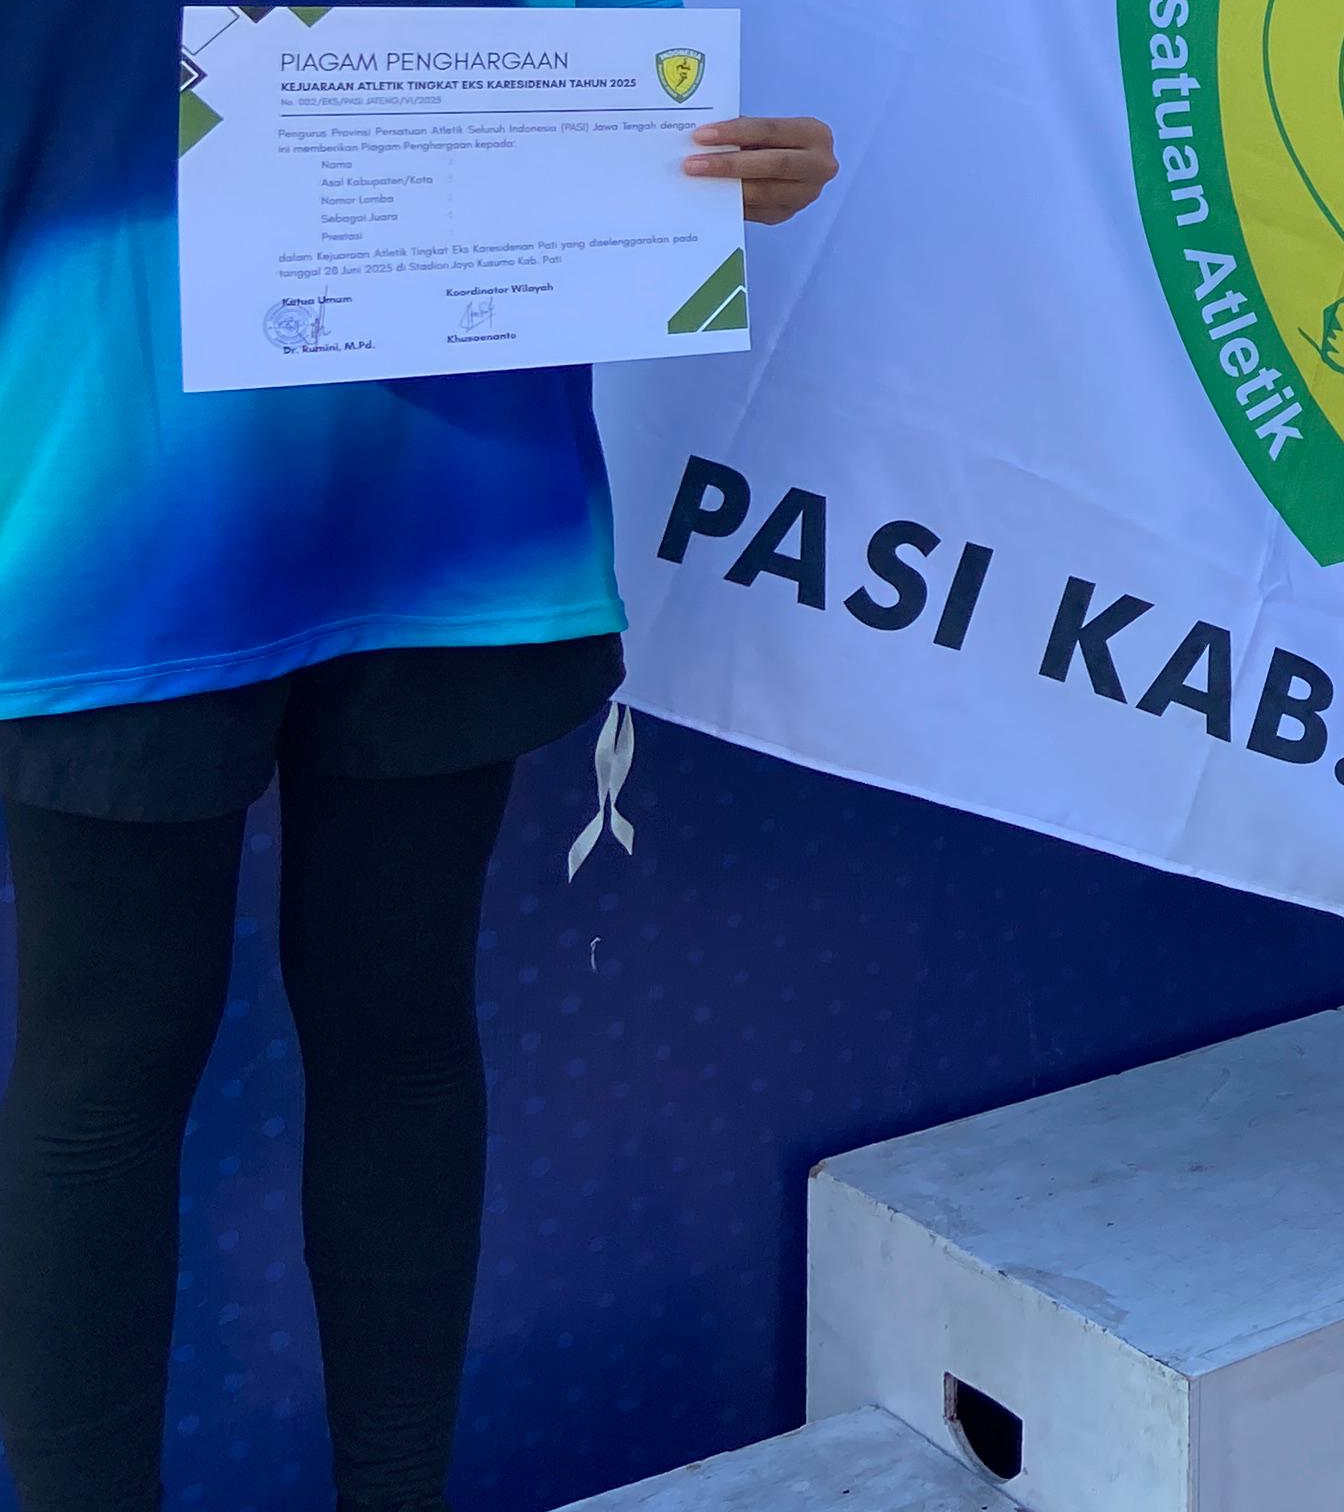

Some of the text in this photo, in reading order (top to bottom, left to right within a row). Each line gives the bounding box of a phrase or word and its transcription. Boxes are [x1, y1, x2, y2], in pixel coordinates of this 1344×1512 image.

[281, 51, 568, 72] PIAGAM PENGHARGAAN
[281, 78, 637, 92] KEJUARAAN ATLETIK TINGKAT EKS KARESIDENAN TAHUN 2025
[278, 121, 696, 140] Pengurus Provinsi Persatuan Atletik Seluruh Indonesia (PASI) Jawa Tengah dengan
[293, 144, 358, 153] memberikan
[361, 143, 401, 154] Piagam
[404, 141, 472, 152] Penghargaan
[321, 161, 352, 169] Nama
[321, 176, 433, 189] Asal Kabupaten/Kota
[321, 194, 394, 205] Nomor Lomba
[321, 213, 398, 225] Sebagai Juara
[321, 232, 363, 241] Prestasi
[278, 234, 698, 262] dalam Kejuaraan Atletik Tingkat Eks Karesidenan Pati yang diselenggarakan pada
[279, 267, 321, 279] tanggal
[325, 267, 338, 276] 28
[341, 266, 361, 275] Juni
[365, 265, 393, 274] 2025
[396, 263, 407, 272] di
[408, 262, 449, 271] Stadion
[542, 255, 562, 264] Pati
[446, 282, 554, 297] Koordinator Wilayah
[282, 296, 352, 307] Ketua Umum
[283, 340, 375, 355] Dr. Rumini, M.Pd.
[1185, 247, 1304, 462] Atletik
[657, 454, 994, 651] PASI
